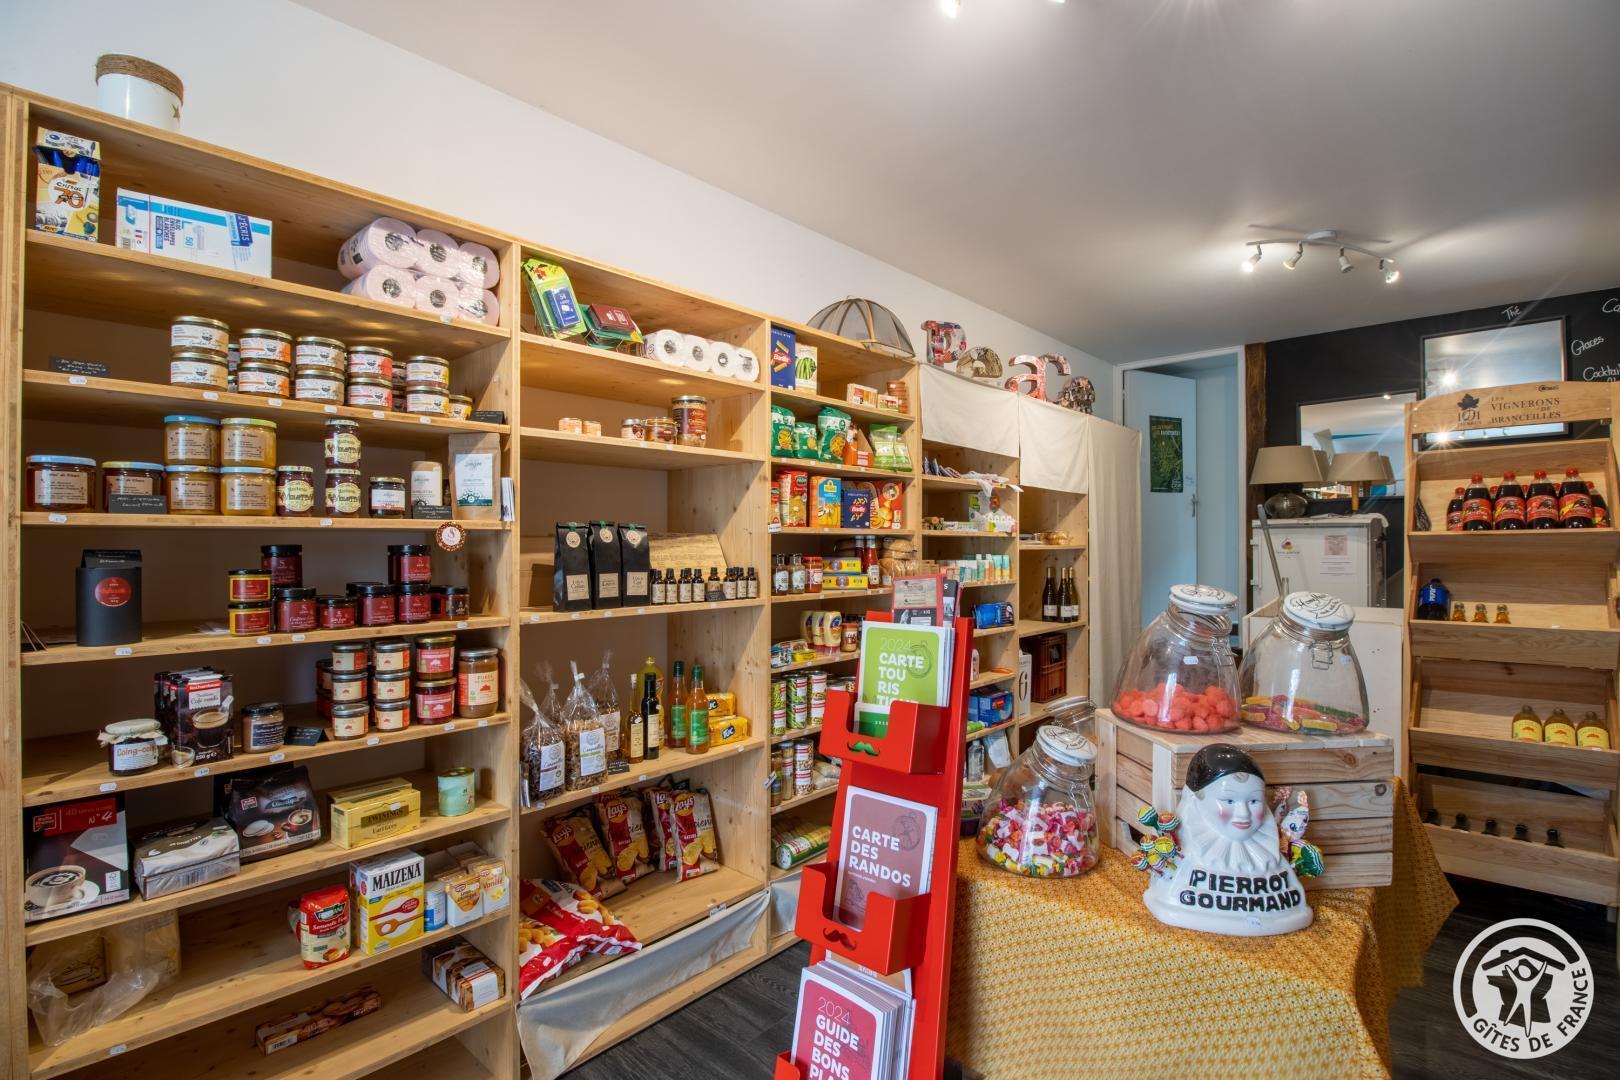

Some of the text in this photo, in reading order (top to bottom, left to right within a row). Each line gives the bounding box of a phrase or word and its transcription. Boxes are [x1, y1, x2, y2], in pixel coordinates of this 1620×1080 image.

[185, 236, 194, 247] 50
[1501, 305, 1522, 321] Thé
[1570, 335, 1605, 356] Glaces
[1491, 397, 1560, 411] VIGNERONS
[1490, 411, 1561, 424] BRANCEILLES
[879, 652, 925, 669] CARTE
[878, 666, 907, 681] TOU
[877, 681, 900, 695] RIS
[723, 728, 734, 738] TUC
[367, 809, 404, 823] TWININGS
[607, 802, 629, 818] Lay's
[552, 825, 573, 843] Lay's
[852, 825, 900, 851] CARTE
[850, 840, 879, 860] DES
[372, 862, 421, 892] MAIZENA
[848, 855, 911, 888] RANDOS
[1188, 869, 1290, 895] PIERROT
[1179, 889, 1301, 913] GOURMAND
[817, 996, 851, 1025] 2024
[815, 1014, 860, 1052] GUIDE
[813, 1030, 842, 1058] DES
[811, 1046, 850, 1080] BONS
